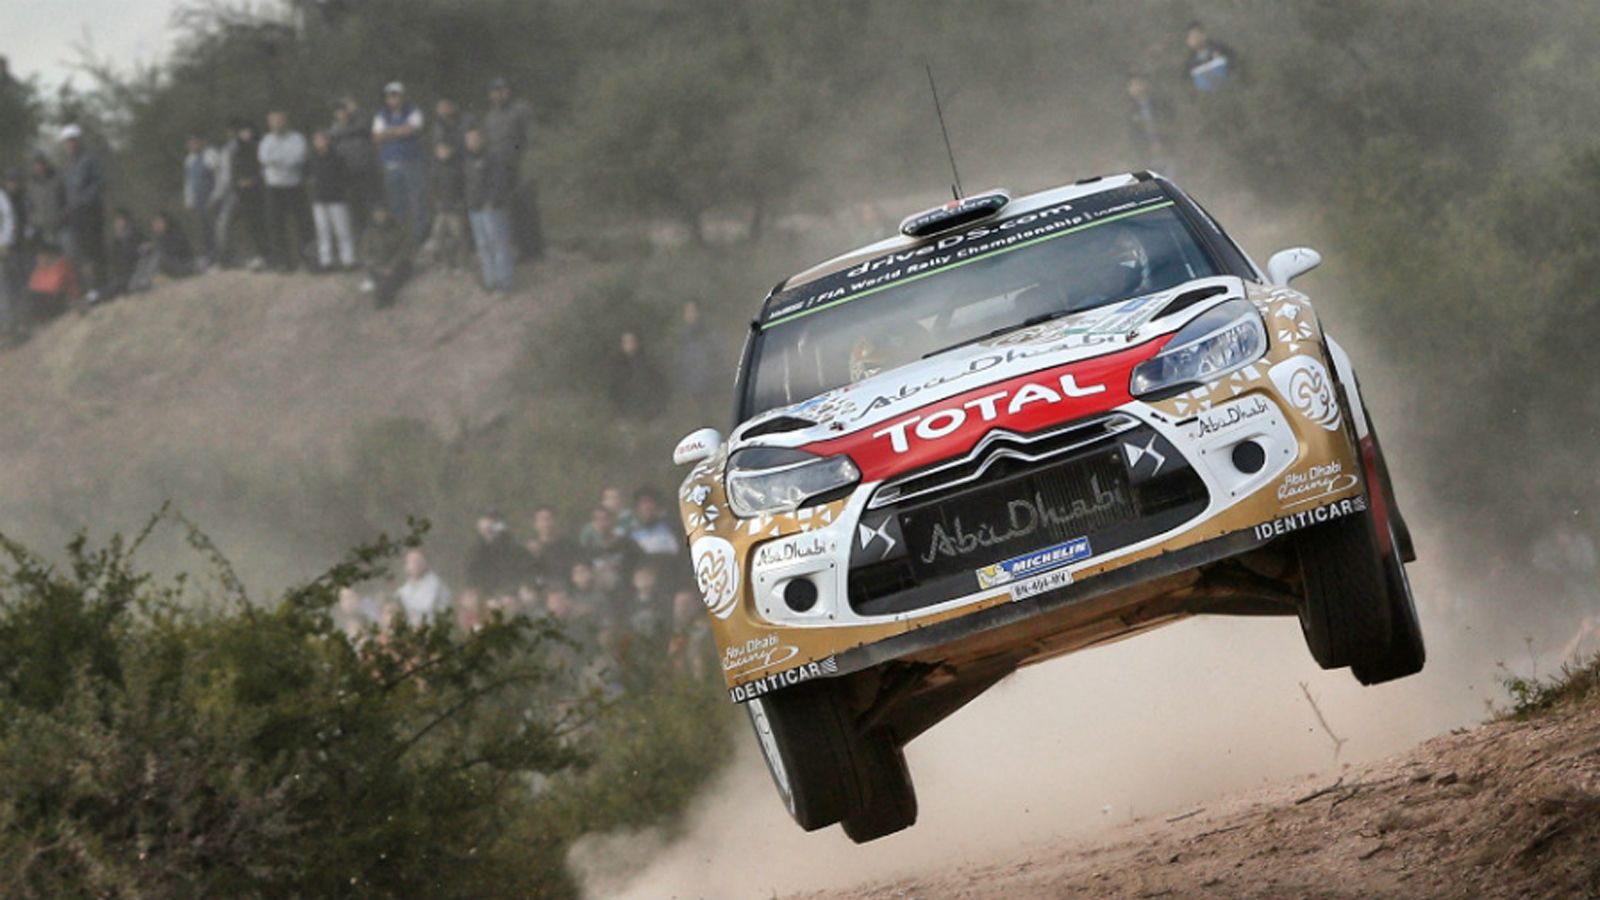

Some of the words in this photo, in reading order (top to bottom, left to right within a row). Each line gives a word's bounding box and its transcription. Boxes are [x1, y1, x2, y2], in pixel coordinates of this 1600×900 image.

[816, 288, 846, 304] FIA
[851, 269, 901, 292] World
[906, 254, 952, 274] Rally
[957, 215, 1083, 259] Championship
[847, 203, 1073, 278] driveDS.com
[872, 373, 1107, 454] TOTAL
[1309, 460, 1342, 480] Dhabi
[1254, 497, 1354, 541] IDENTICAR
[1011, 541, 1087, 573] MICHELIN
[746, 631, 779, 653] Dhabi
[729, 661, 822, 703] IDENTICAR
